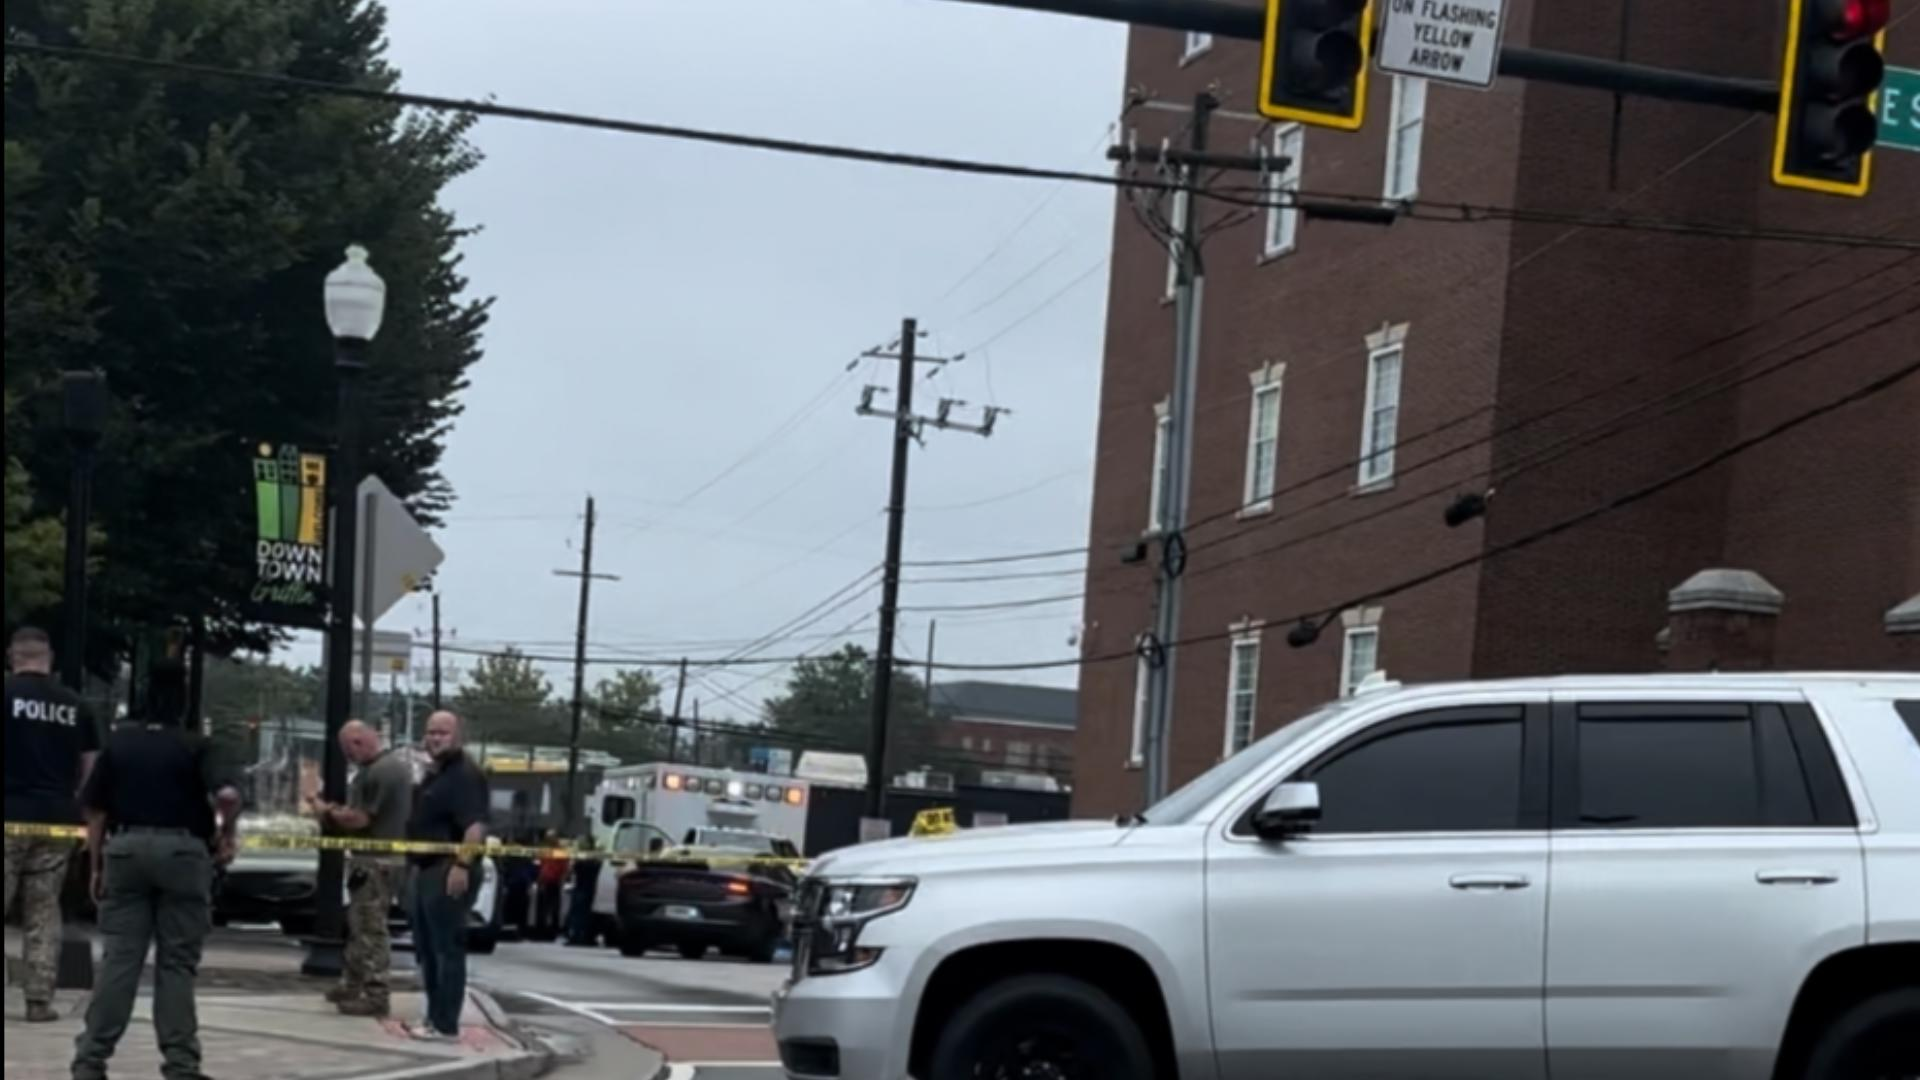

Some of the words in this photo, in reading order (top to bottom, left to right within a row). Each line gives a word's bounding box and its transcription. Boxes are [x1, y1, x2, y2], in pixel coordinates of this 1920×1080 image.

[1391, 0, 1414, 14] ON
[1421, 0, 1497, 29] FLASHING
[1413, 23, 1474, 48] YELLOW
[1408, 48, 1464, 71] ARROW
[1882, 88, 1901, 126] E
[257, 540, 323, 563] DOWN
[257, 559, 322, 584] TOWN
[13, 698, 77, 726] POLICE
